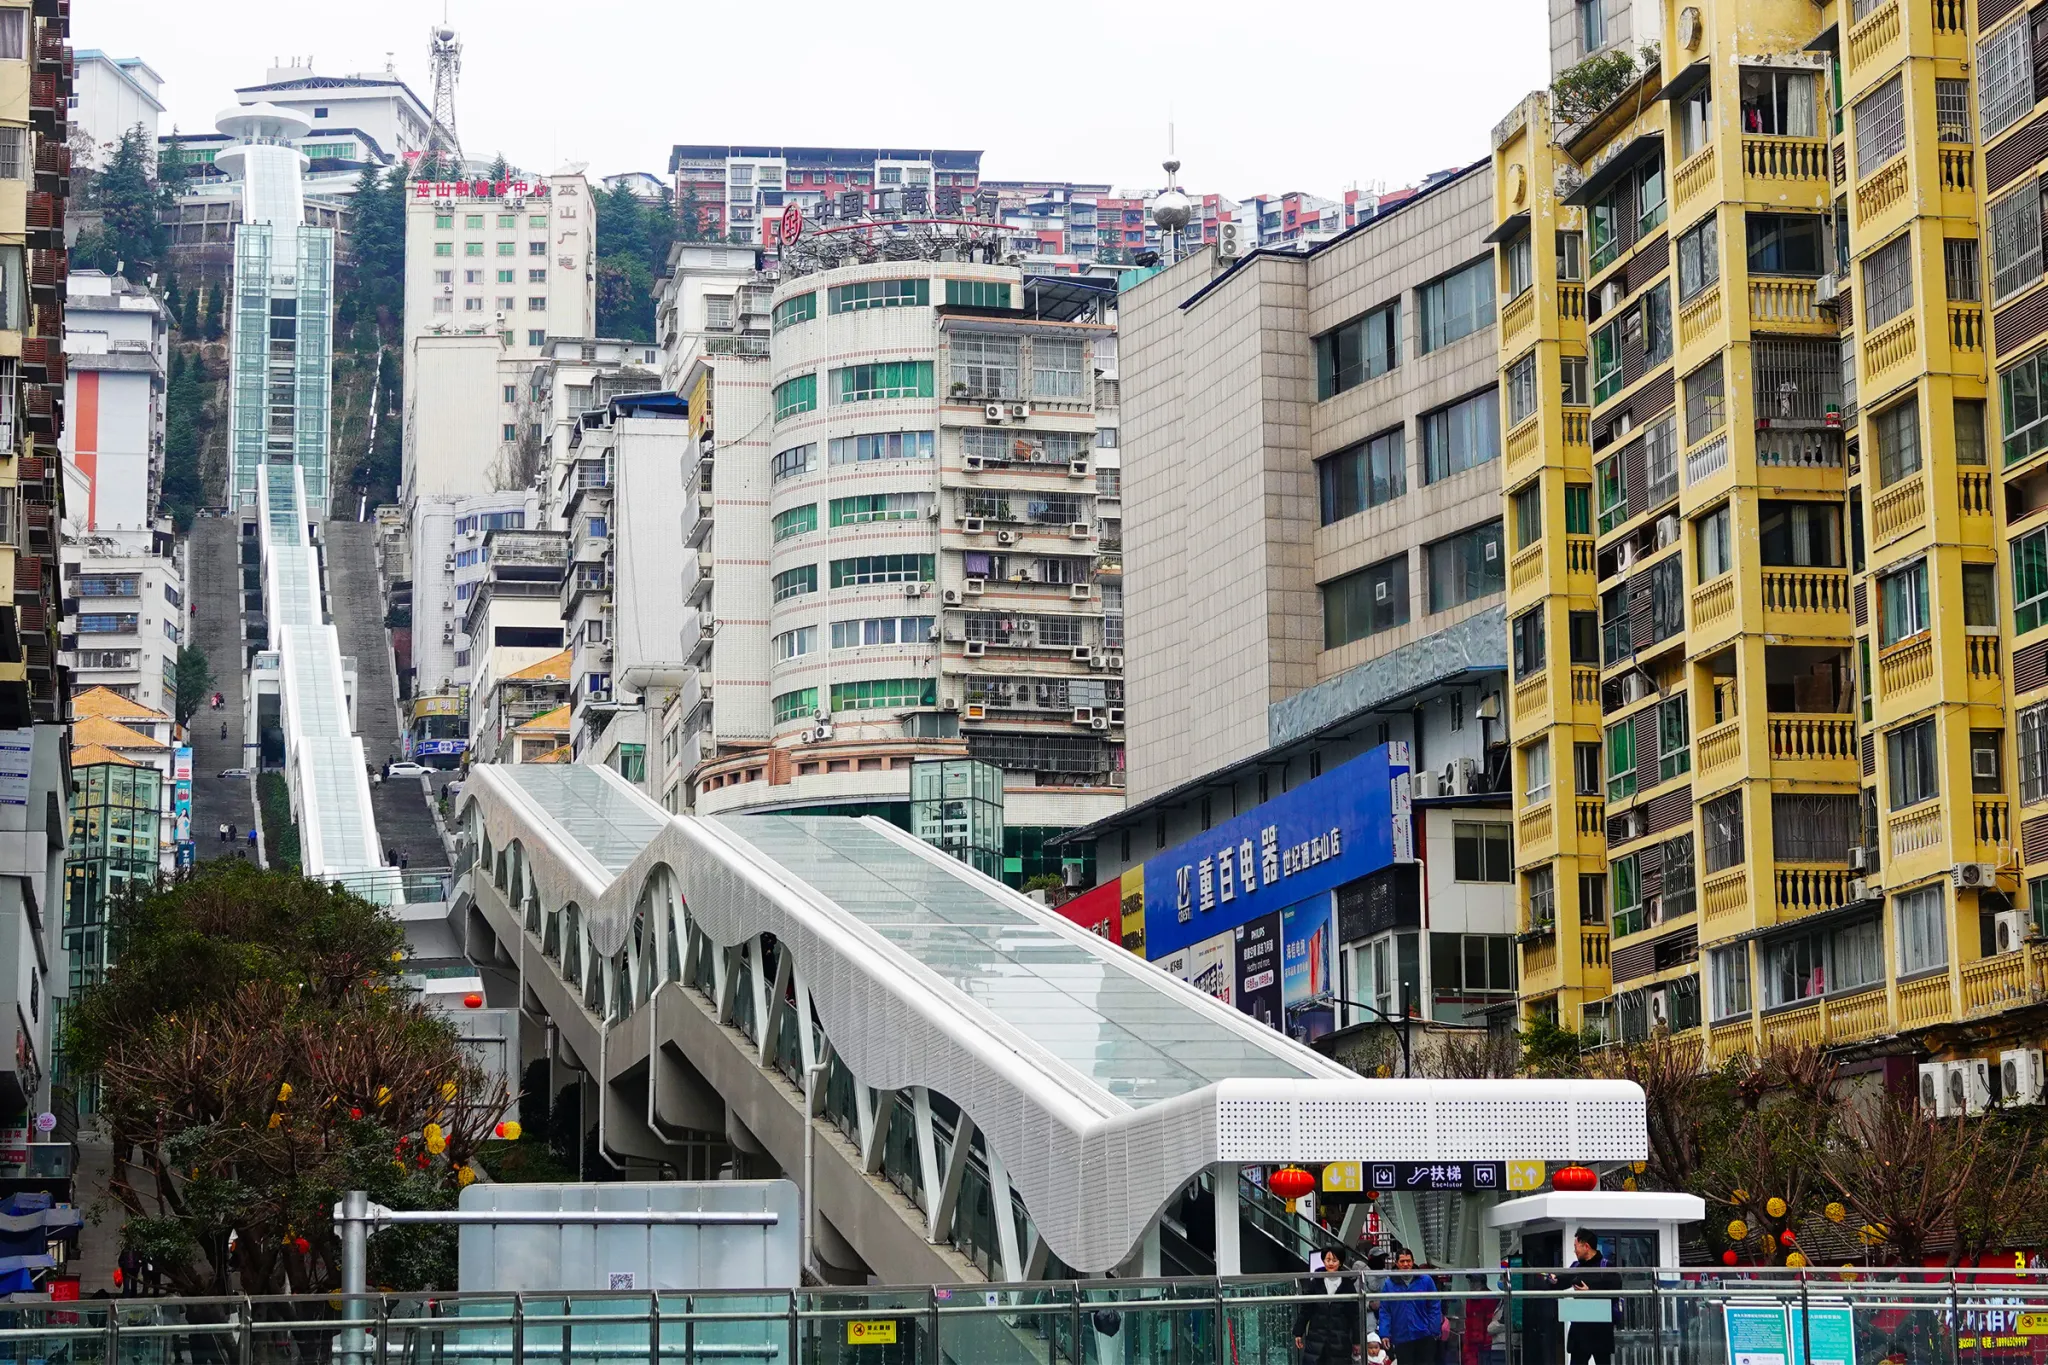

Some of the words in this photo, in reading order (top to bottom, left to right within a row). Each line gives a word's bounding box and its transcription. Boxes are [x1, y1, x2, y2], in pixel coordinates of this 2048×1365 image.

[416, 180, 547, 198] 巫山融媒体中心
[813, 187, 999, 225] 中国工商银行
[557, 184, 578, 270] 巫山广电
[1198, 824, 1279, 912] 重百电器
[1282, 827, 1342, 877] 世纪通巫山店
[1250, 926, 1265, 940] PHILIPS
[1345, 1165, 1355, 1188] 出口
[1430, 1165, 1462, 1181] 扶梯
[1512, 1166, 1523, 1187] 入口
